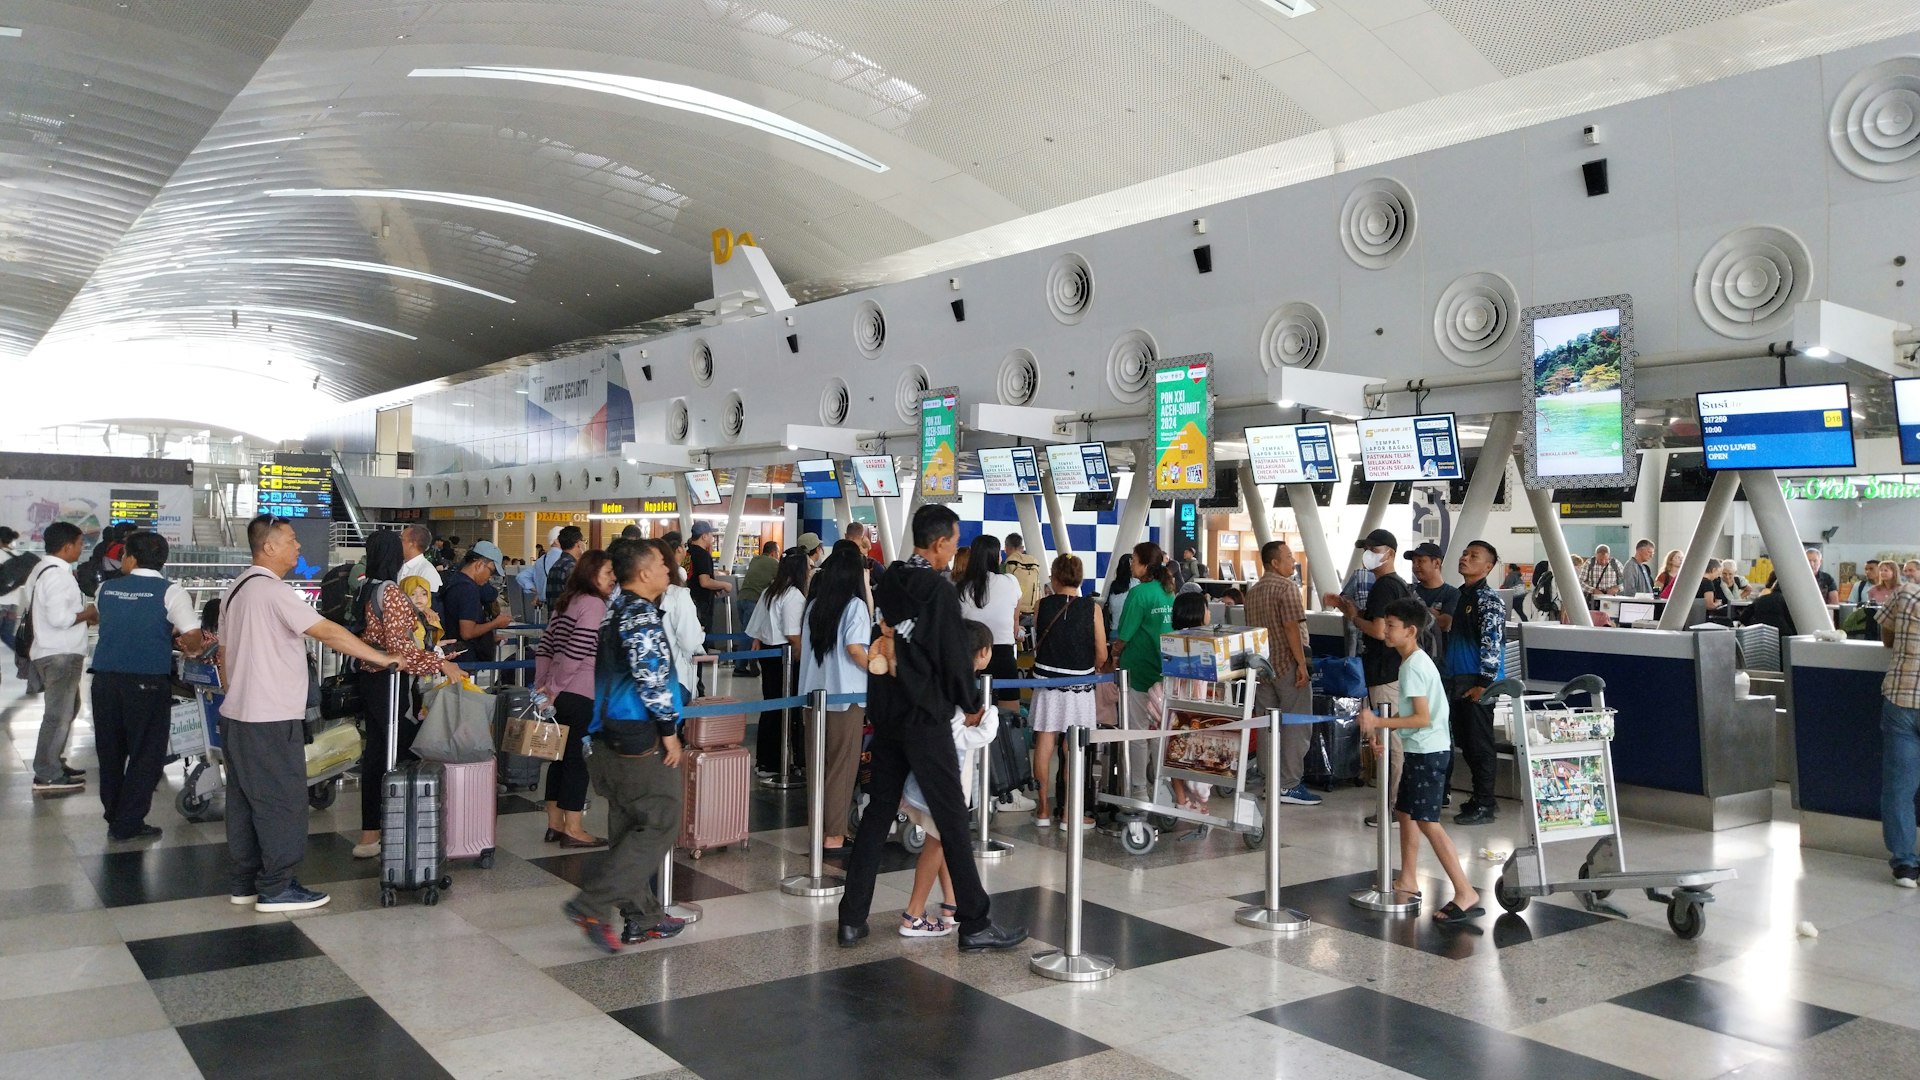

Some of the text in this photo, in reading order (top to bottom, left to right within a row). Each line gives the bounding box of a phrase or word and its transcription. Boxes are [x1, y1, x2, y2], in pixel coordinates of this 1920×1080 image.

[544, 379, 589, 403] AIRPORT SECURITY
[1161, 390, 1185, 404] PON XXI
[1161, 402, 1200, 417] ACEH-SUMUT
[1702, 400, 1728, 410] Susi
[926, 418, 934, 427] PON
[1161, 417, 1177, 429] 2024
[1703, 415, 1841, 424] SI7259 D18
[925, 425, 951, 436] ACEH-SUMUT
[1365, 428, 1389, 438] SUPER
[926, 437, 936, 447] 2024
[1707, 443, 1756, 452] GAYO LUWES
[283, 465, 321, 473] Keberangkatan
[602, 503, 623, 513] Medan
